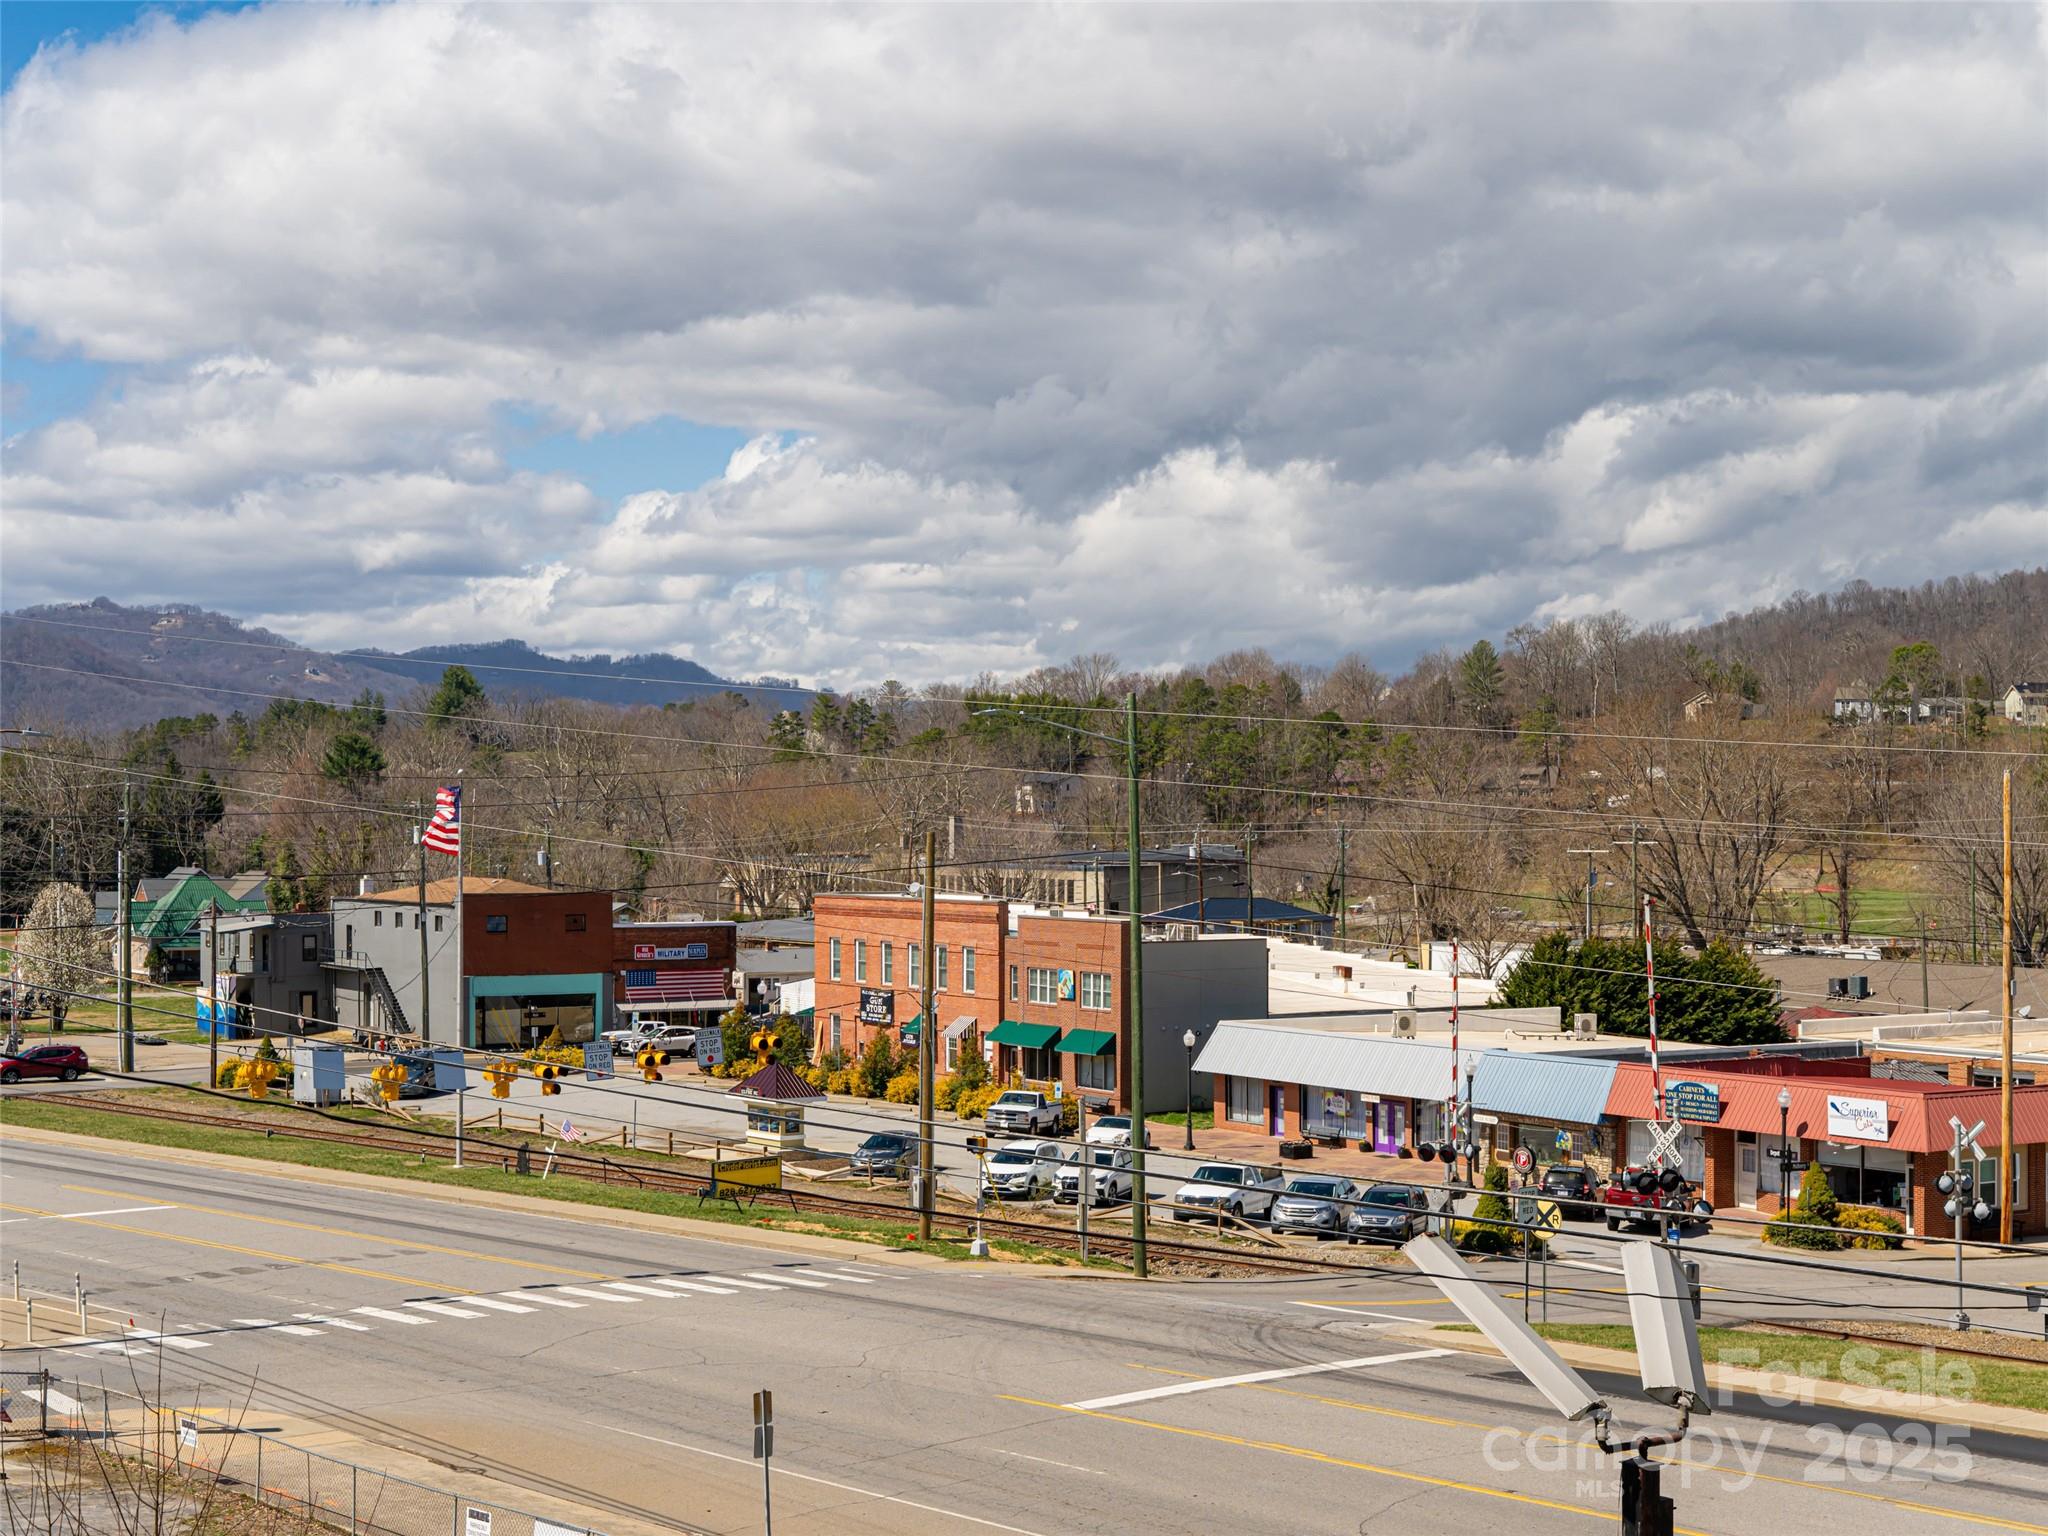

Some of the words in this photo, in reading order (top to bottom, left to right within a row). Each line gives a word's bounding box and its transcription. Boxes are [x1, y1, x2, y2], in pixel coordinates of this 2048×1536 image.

[657, 950, 685, 958] MILITARY
[869, 997, 883, 1005] GUN
[866, 1004, 887, 1013] STORE
[696, 1029, 721, 1038] CROSSWALK
[585, 1043, 611, 1051] CROSSWALK
[700, 1039, 718, 1048] STOP
[589, 1053, 608, 1062] STOP
[598, 1061, 611, 1069] RED
[1841, 1101, 1879, 1120] Superior
[1855, 1117, 1873, 1132] Cuts
[1647, 1122, 1681, 1164] CROSSING
[1552, 1215, 1559, 1224] R
